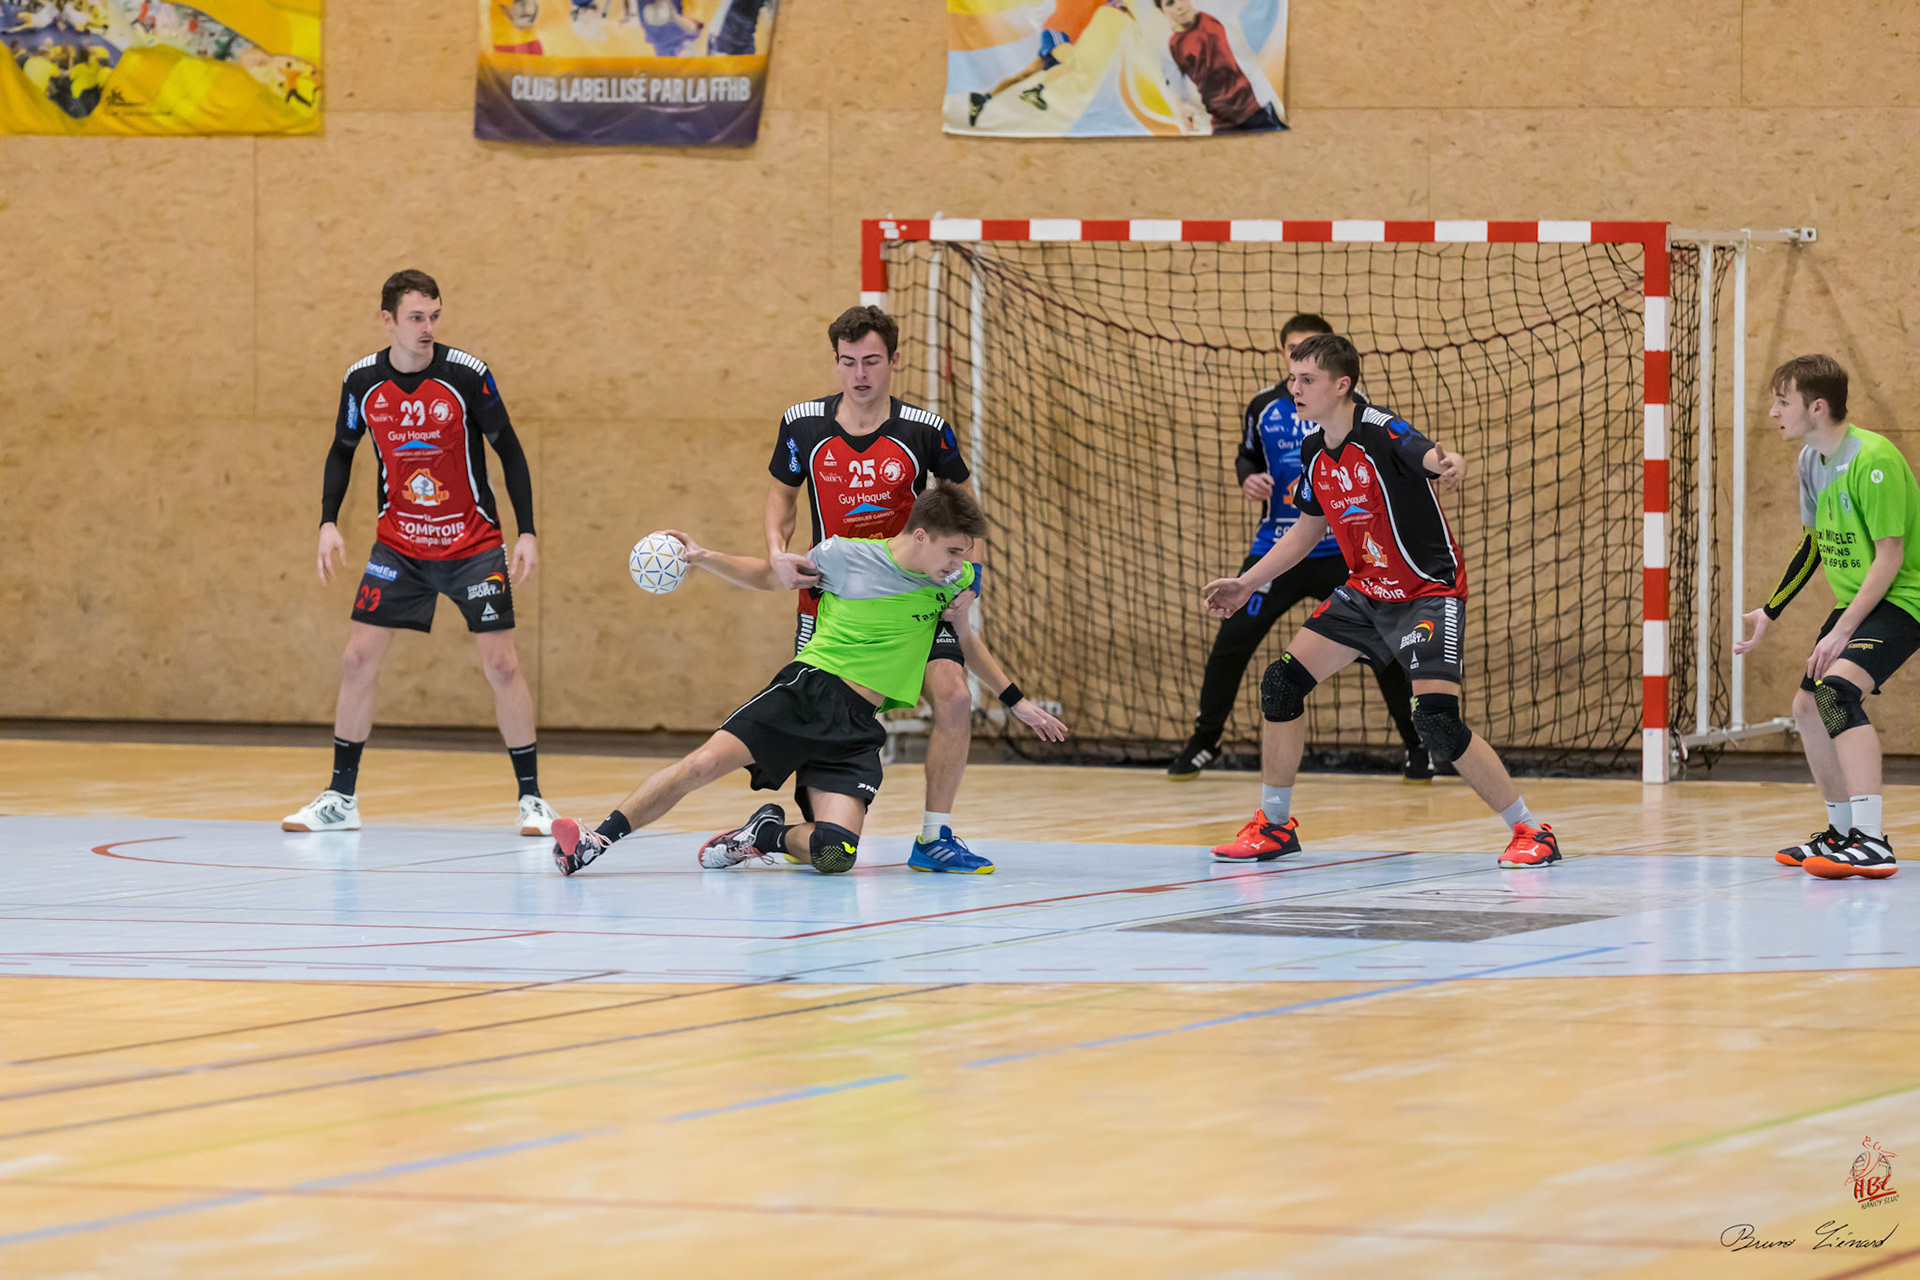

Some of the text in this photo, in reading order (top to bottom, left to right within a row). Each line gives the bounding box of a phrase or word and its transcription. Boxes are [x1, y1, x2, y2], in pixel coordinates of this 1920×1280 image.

[511, 73, 751, 103] CLUB LABELLISÉ PAR LA FFHB
[400, 400, 426, 426] 29
[387, 429, 442, 442] Guy Hoquet
[1277, 439, 1294, 450] Guy
[848, 459, 876, 488] 25
[838, 490, 892, 506] Guy Hoquet
[1330, 499, 1345, 510] Guy
